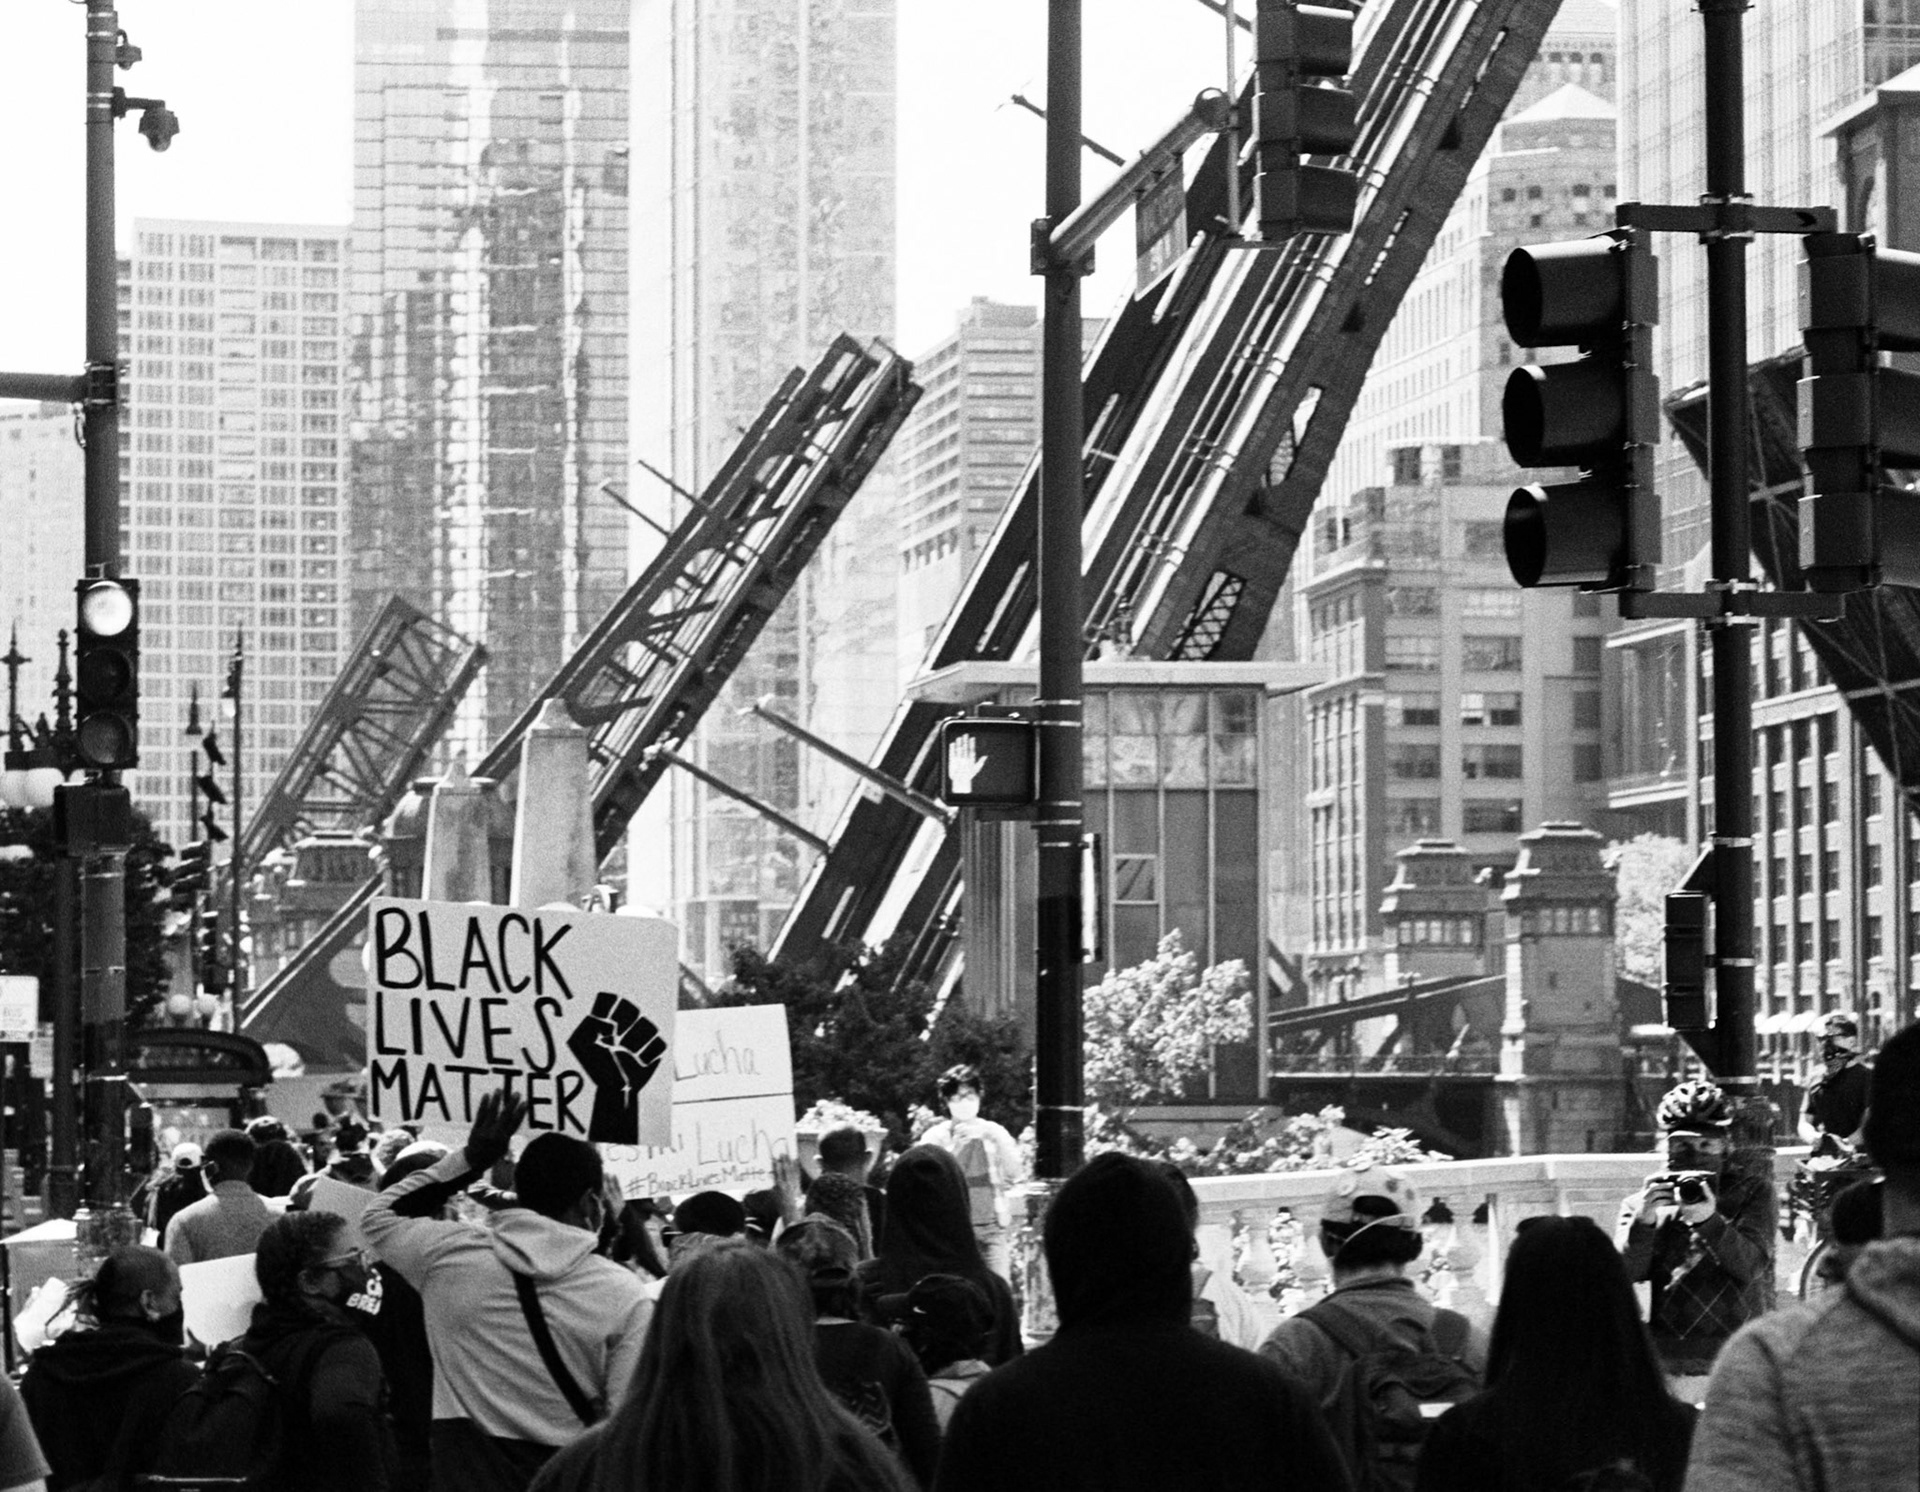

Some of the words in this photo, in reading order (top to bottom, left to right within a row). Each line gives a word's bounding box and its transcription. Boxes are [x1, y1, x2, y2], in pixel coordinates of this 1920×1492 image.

[376, 907, 573, 1000] BLACK
[375, 991, 563, 1074] LIVES
[674, 1029, 761, 1082] Lucha
[371, 1057, 587, 1135] MATTER
[696, 1119, 789, 1166] Lucha
[625, 1165, 776, 1197] #BlackLivesMatte
